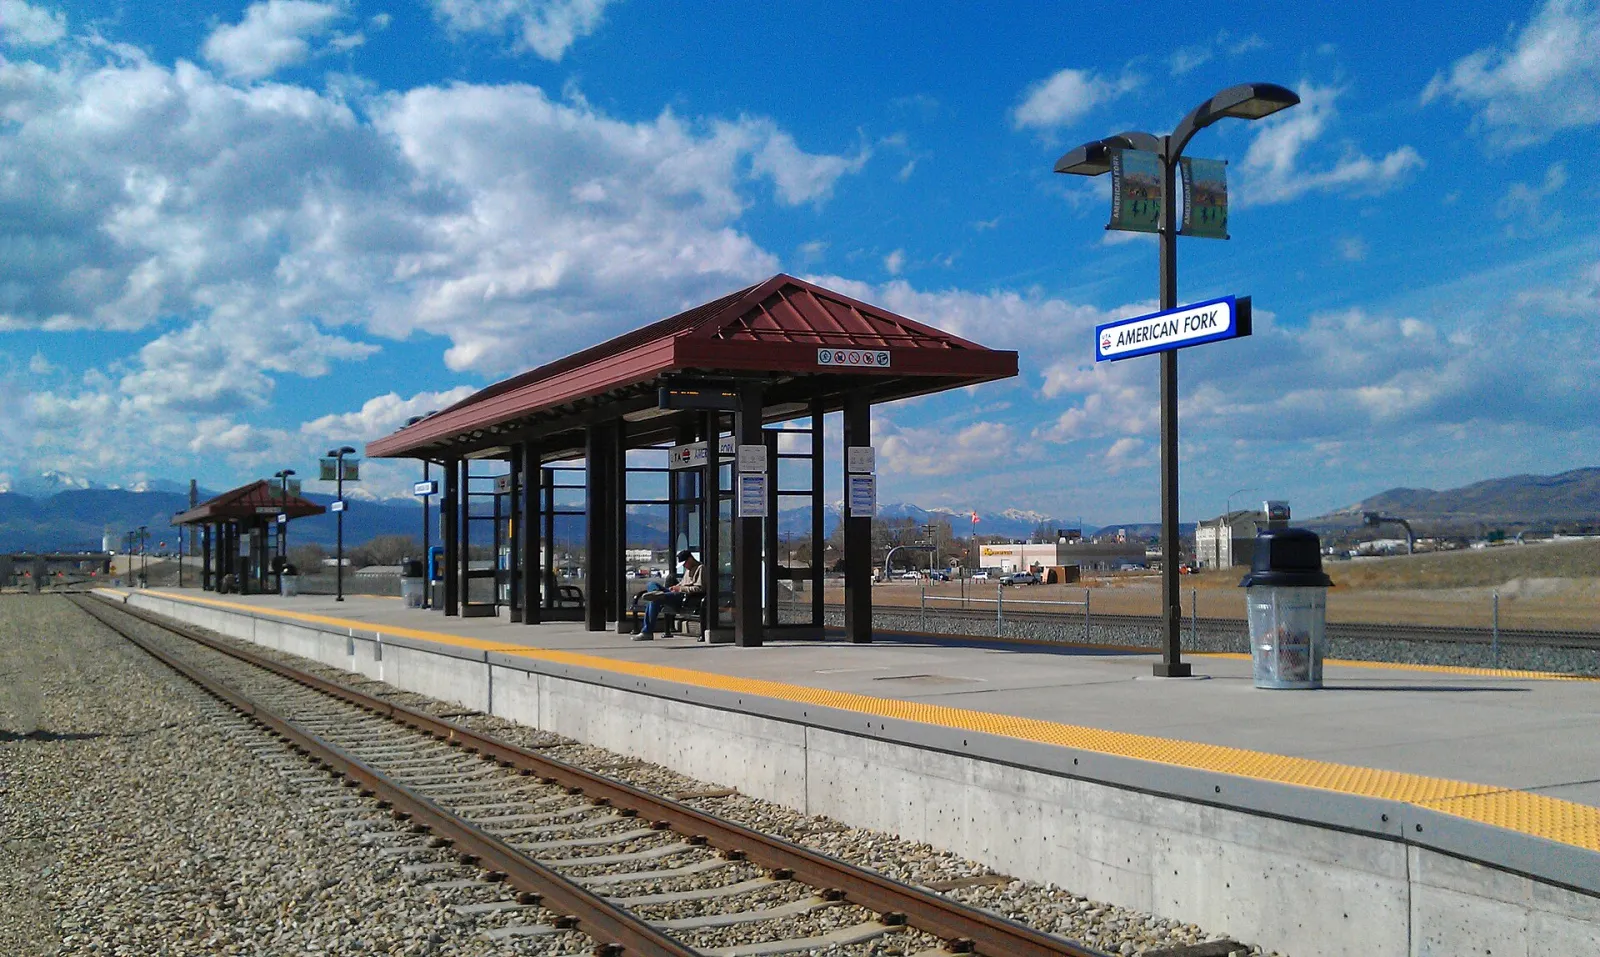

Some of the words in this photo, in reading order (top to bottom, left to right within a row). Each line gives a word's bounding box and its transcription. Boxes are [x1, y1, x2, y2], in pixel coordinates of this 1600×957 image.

[1113, 177, 1121, 218] AMERICAN
[1183, 184, 1191, 224] AMERICAN
[1116, 318, 1180, 347] AMERICAN
[1183, 310, 1218, 333] FORK
